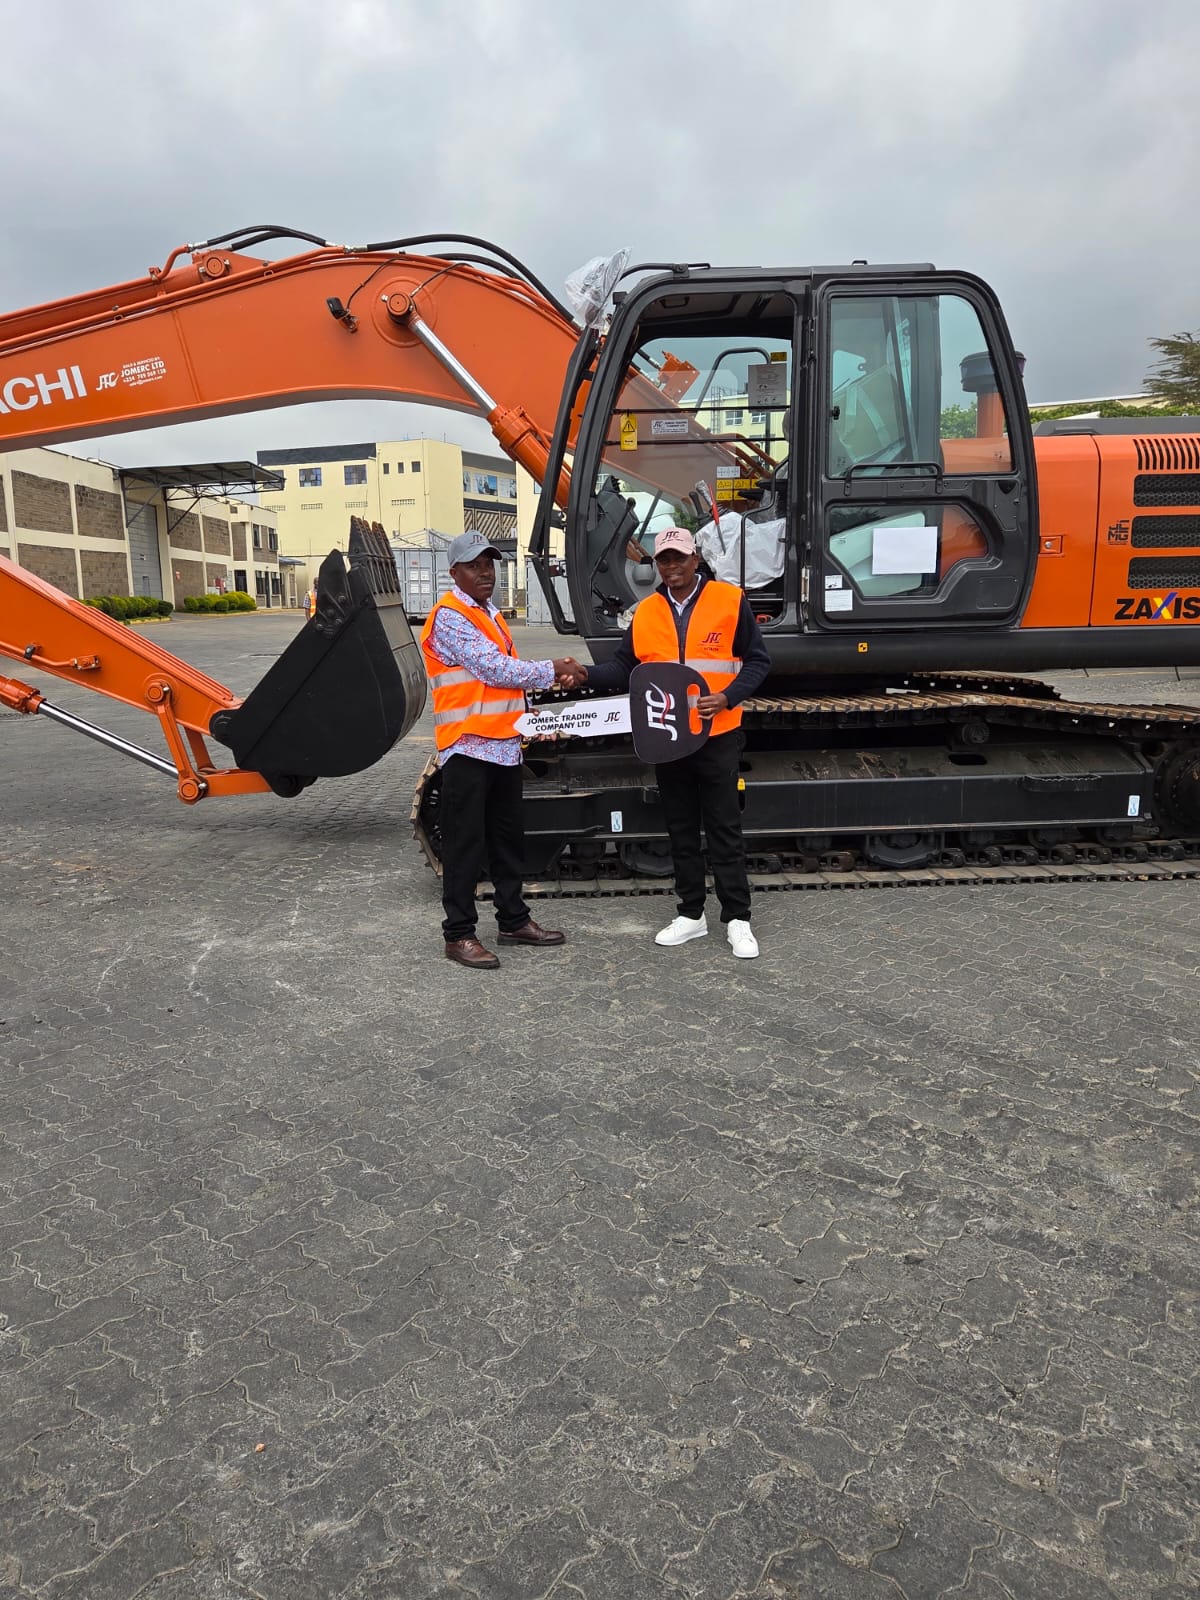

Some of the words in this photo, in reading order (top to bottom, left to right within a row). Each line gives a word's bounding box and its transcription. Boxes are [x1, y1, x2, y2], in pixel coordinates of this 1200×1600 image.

[121, 363, 150, 377] JOMERC
[152, 361, 164, 370] LTD
[0, 365, 87, 414] CHI
[1115, 592, 1200, 620] ZAXIS
[527, 715, 559, 725] JOMERC
[562, 712, 597, 722] TRADING
[604, 711, 621, 723] JTC
[645, 689, 678, 741] JTC
[535, 721, 575, 732] COMPANY
[577, 720, 591, 728] LTD
